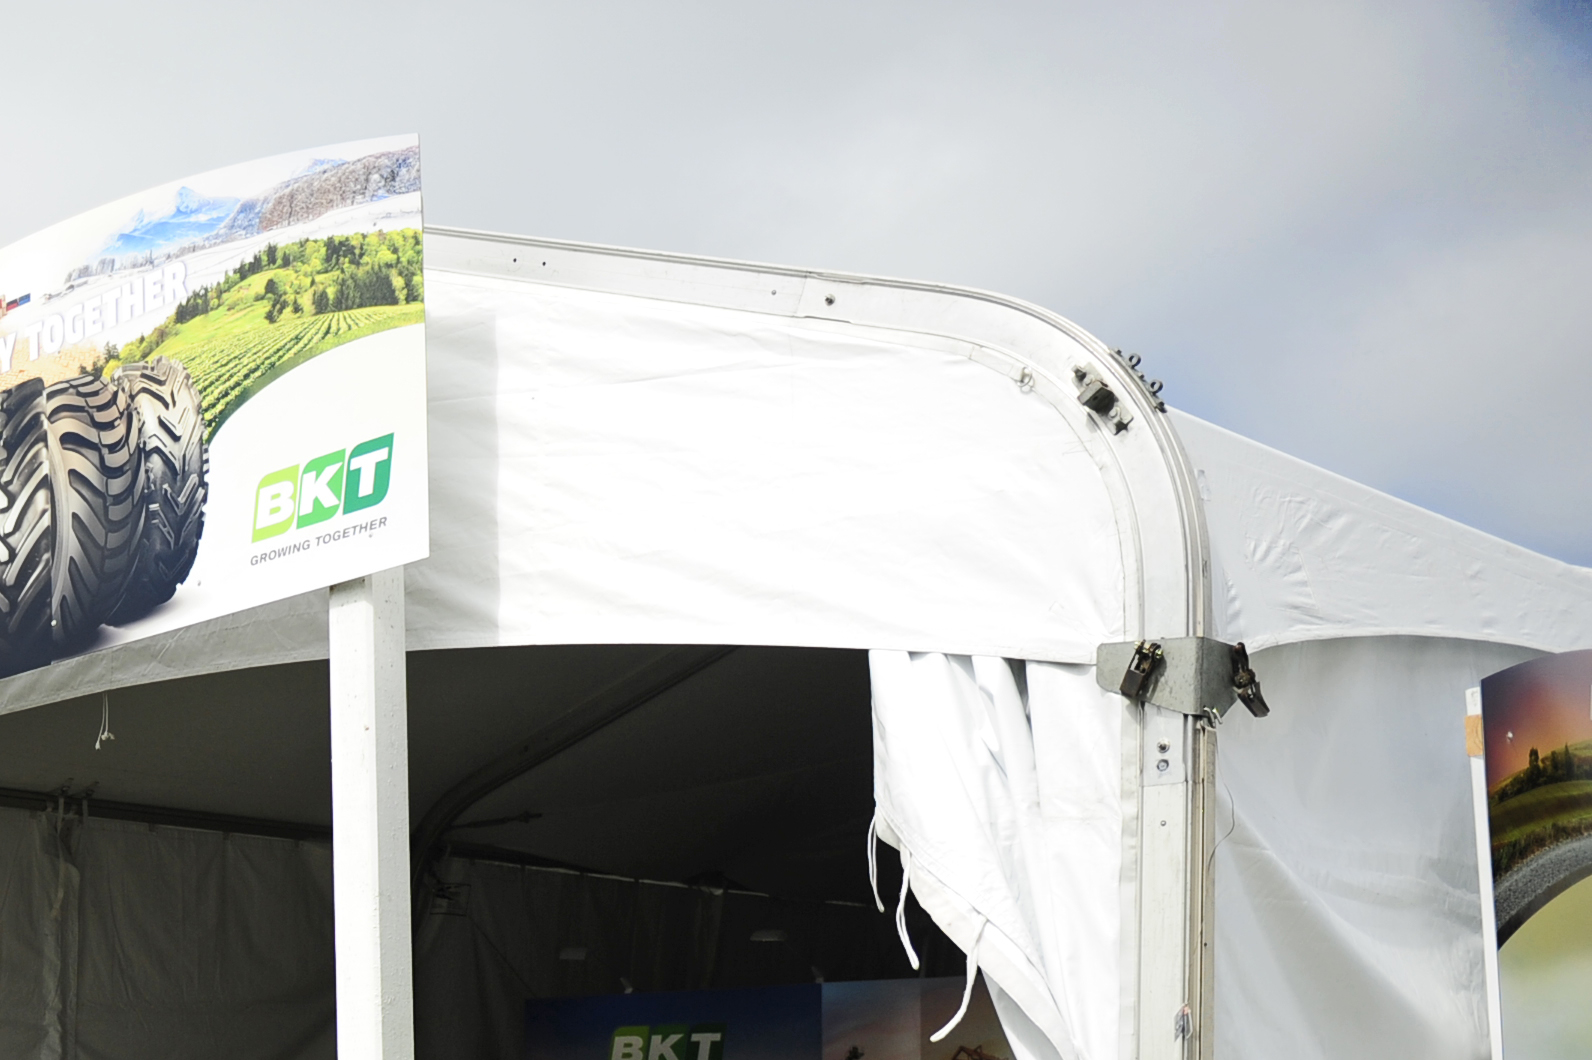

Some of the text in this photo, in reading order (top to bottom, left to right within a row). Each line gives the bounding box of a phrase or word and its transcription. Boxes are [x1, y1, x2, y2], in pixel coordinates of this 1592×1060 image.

[23, 260, 189, 362] TOGETHER
[254, 445, 391, 531] BKT
[250, 516, 388, 566] GROWING TOGETHER
